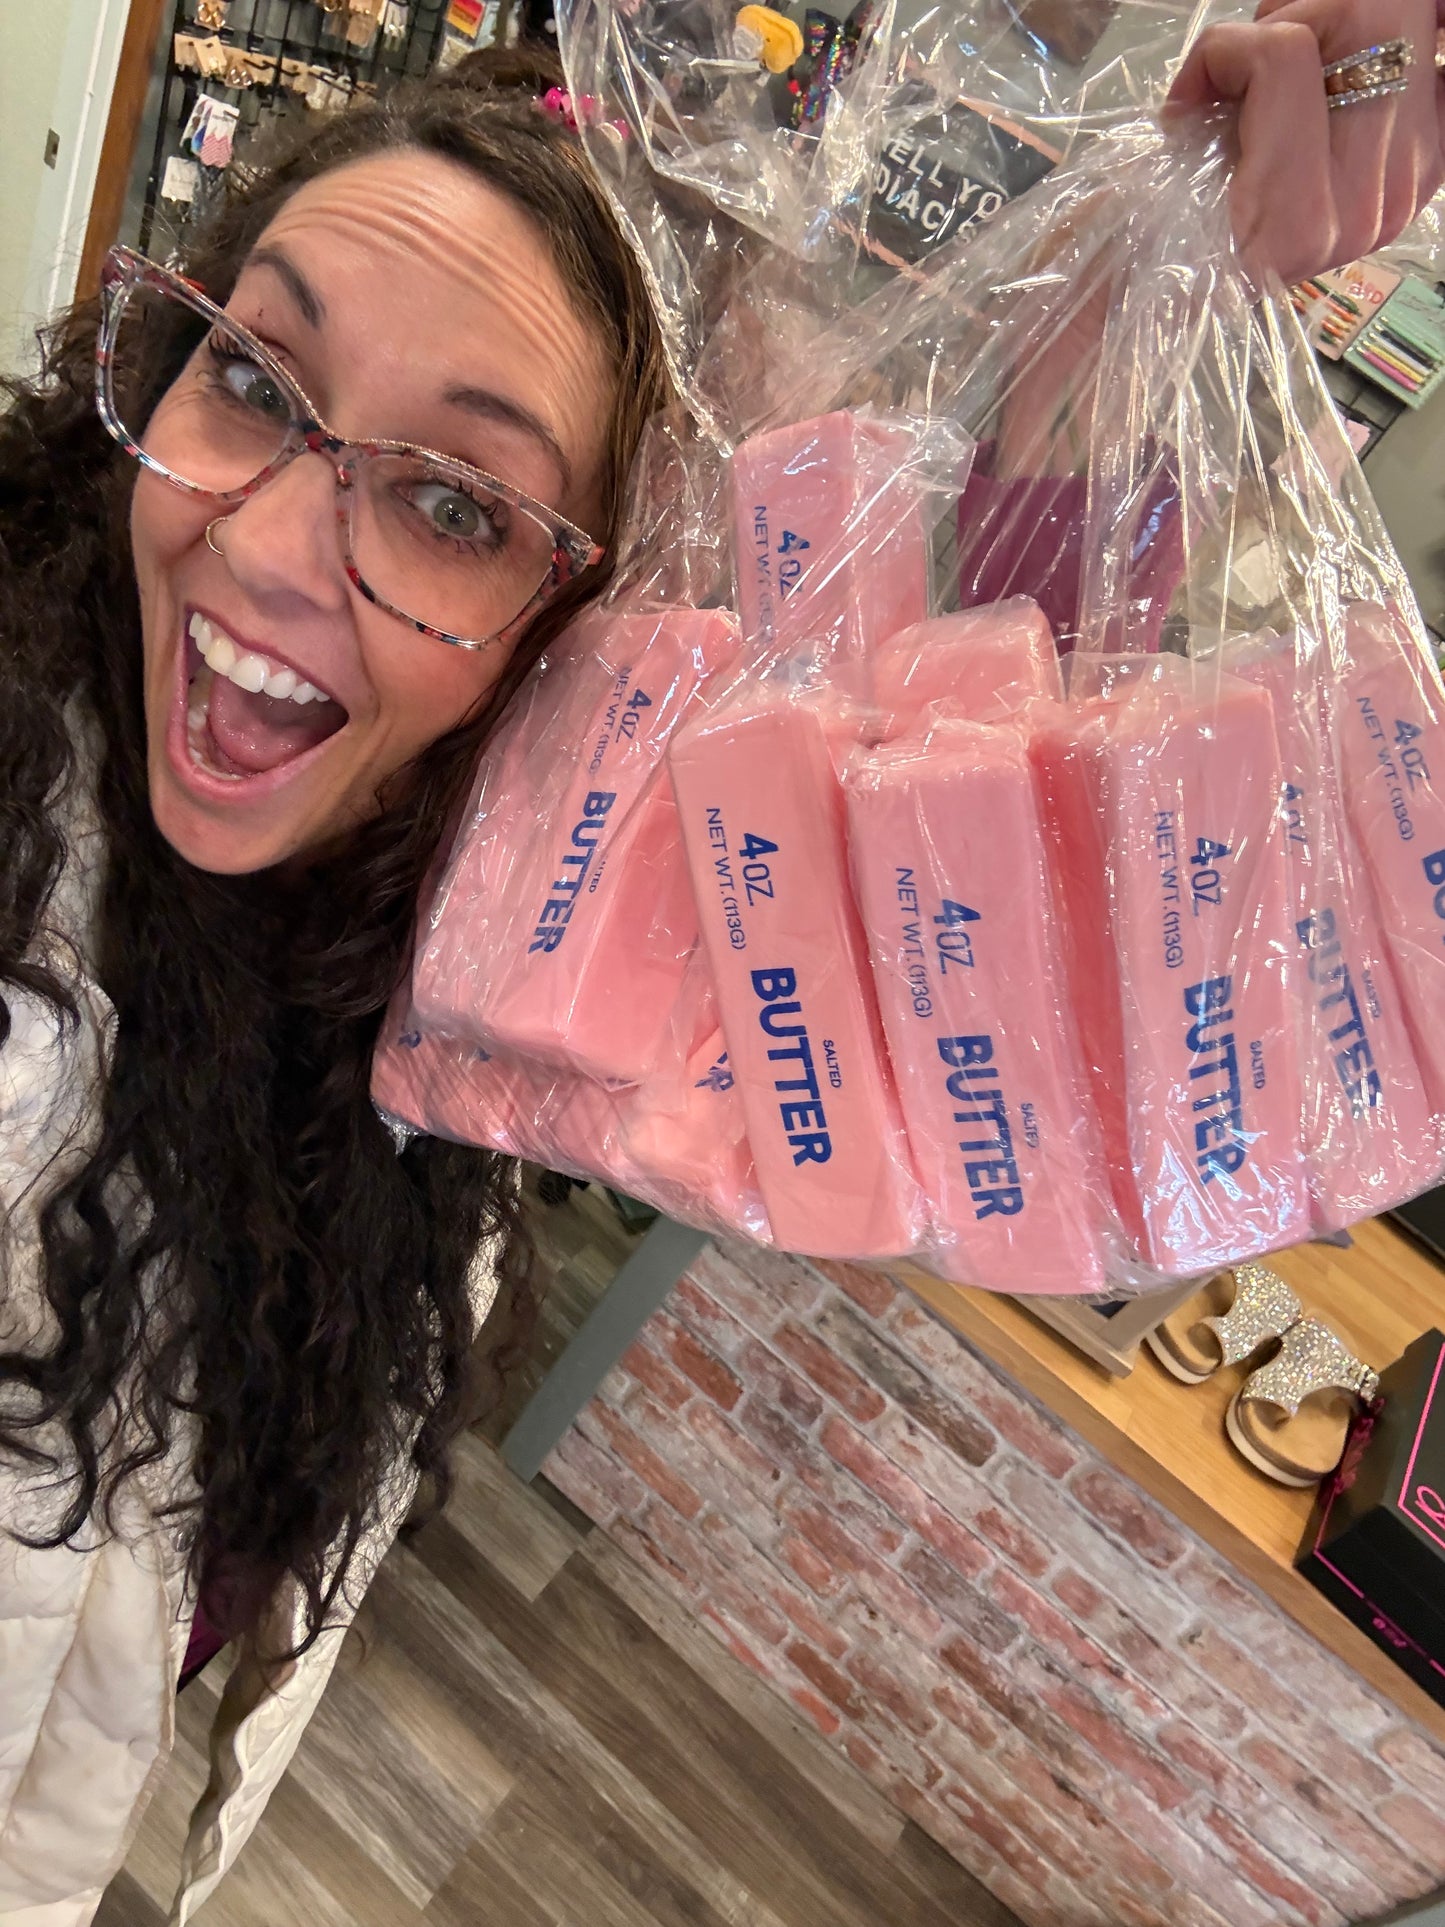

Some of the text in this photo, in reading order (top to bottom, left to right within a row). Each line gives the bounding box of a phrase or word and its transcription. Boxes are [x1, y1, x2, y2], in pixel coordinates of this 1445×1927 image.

[874, 163, 946, 230] DIAC
[884, 130, 944, 189] ELL
[958, 176, 1003, 221] YO
[754, 505, 769, 549] NET
[1356, 697, 1386, 741] NET
[1390, 787, 1415, 841] (113G)
[528, 791, 617, 954] BUTTER
[706, 808, 747, 950] NET WT. (113G)
[896, 868, 933, 1018] NET WT. (113G)
[1154, 811, 1184, 968] NET WT. (113G)
[750, 967, 832, 1167] BUTTER
[823, 1039, 842, 1089] SALTED
[1184, 975, 1246, 1185] BUTTER
[1296, 907, 1382, 1119] BUTTER
[937, 1034, 1025, 1220] BUTTER
[1021, 1102, 1039, 1149] SALTED
